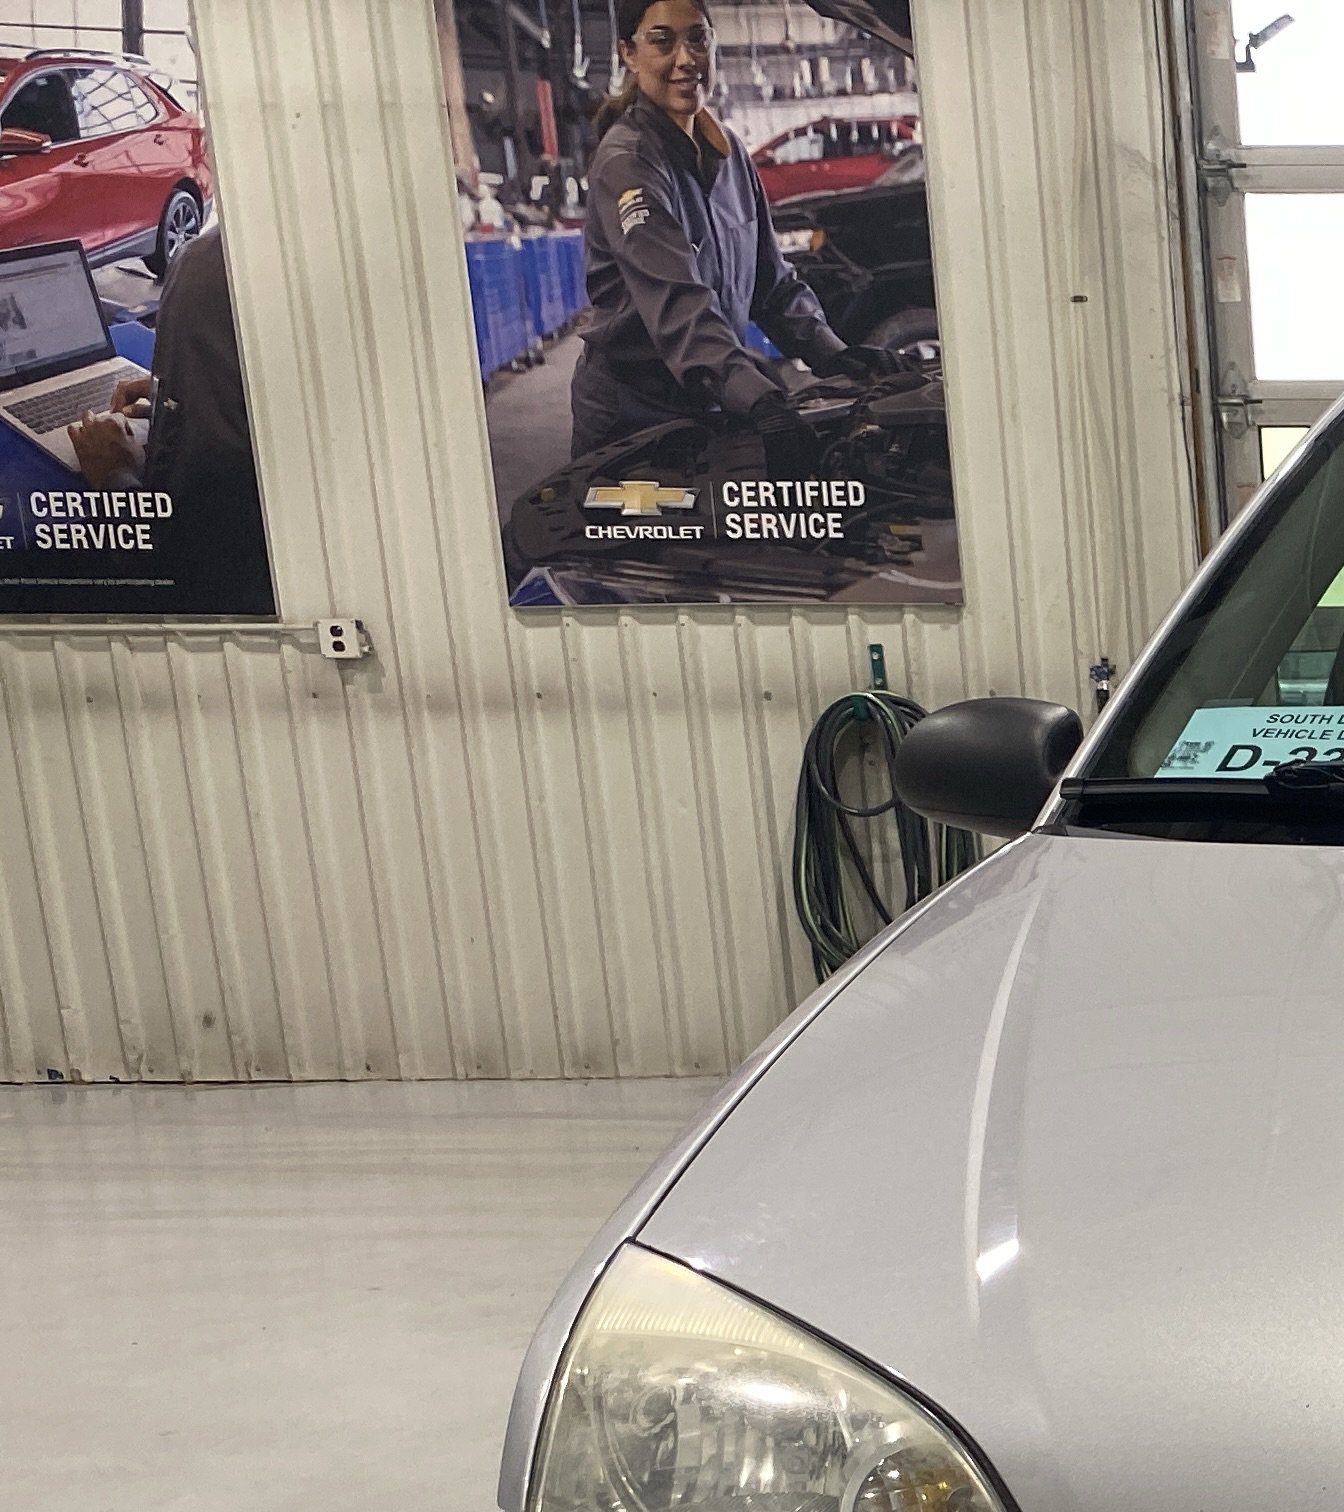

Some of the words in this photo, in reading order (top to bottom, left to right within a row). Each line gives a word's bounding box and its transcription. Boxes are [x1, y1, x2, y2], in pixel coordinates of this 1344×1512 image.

[29, 491, 173, 518] CERTIFIED
[721, 481, 866, 507] CERTIFIED
[34, 523, 154, 550] SERVICE
[585, 525, 705, 539] CHEVROLET
[725, 513, 845, 539] SERVICE
[1266, 713, 1332, 725] SOUTH
[1252, 728, 1334, 740] VEHICLE
